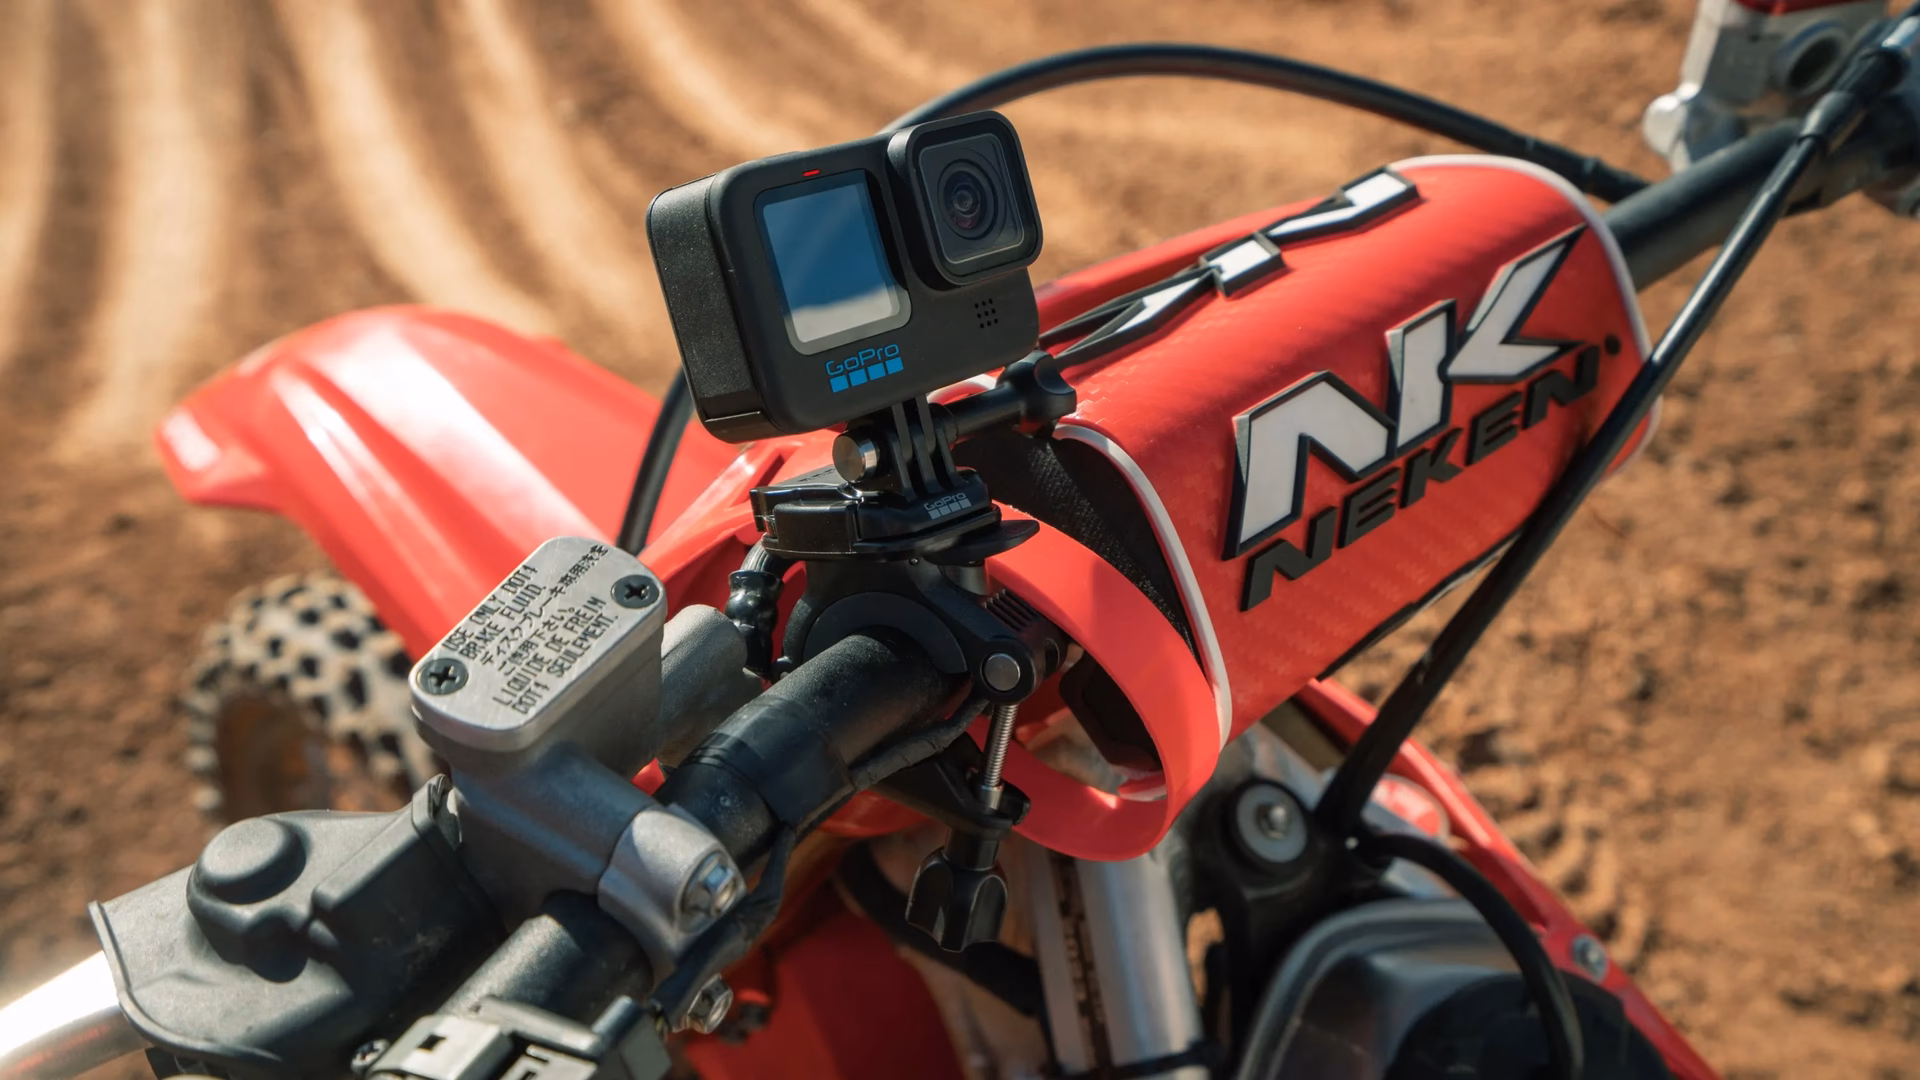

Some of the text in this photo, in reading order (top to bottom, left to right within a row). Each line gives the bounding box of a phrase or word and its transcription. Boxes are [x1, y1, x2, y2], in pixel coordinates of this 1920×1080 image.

[825, 343, 900, 376] GoPro
[923, 492, 967, 511] GoPro
[1240, 346, 1602, 612] NEKEN
[441, 564, 538, 651] USE ONLY DOT4
[459, 584, 547, 660] BRAKE FLUID.
[492, 653, 552, 706] LIQUIDE
[545, 634, 570, 653] DE
[511, 613, 619, 714] DOT4 SEULEMENT.
